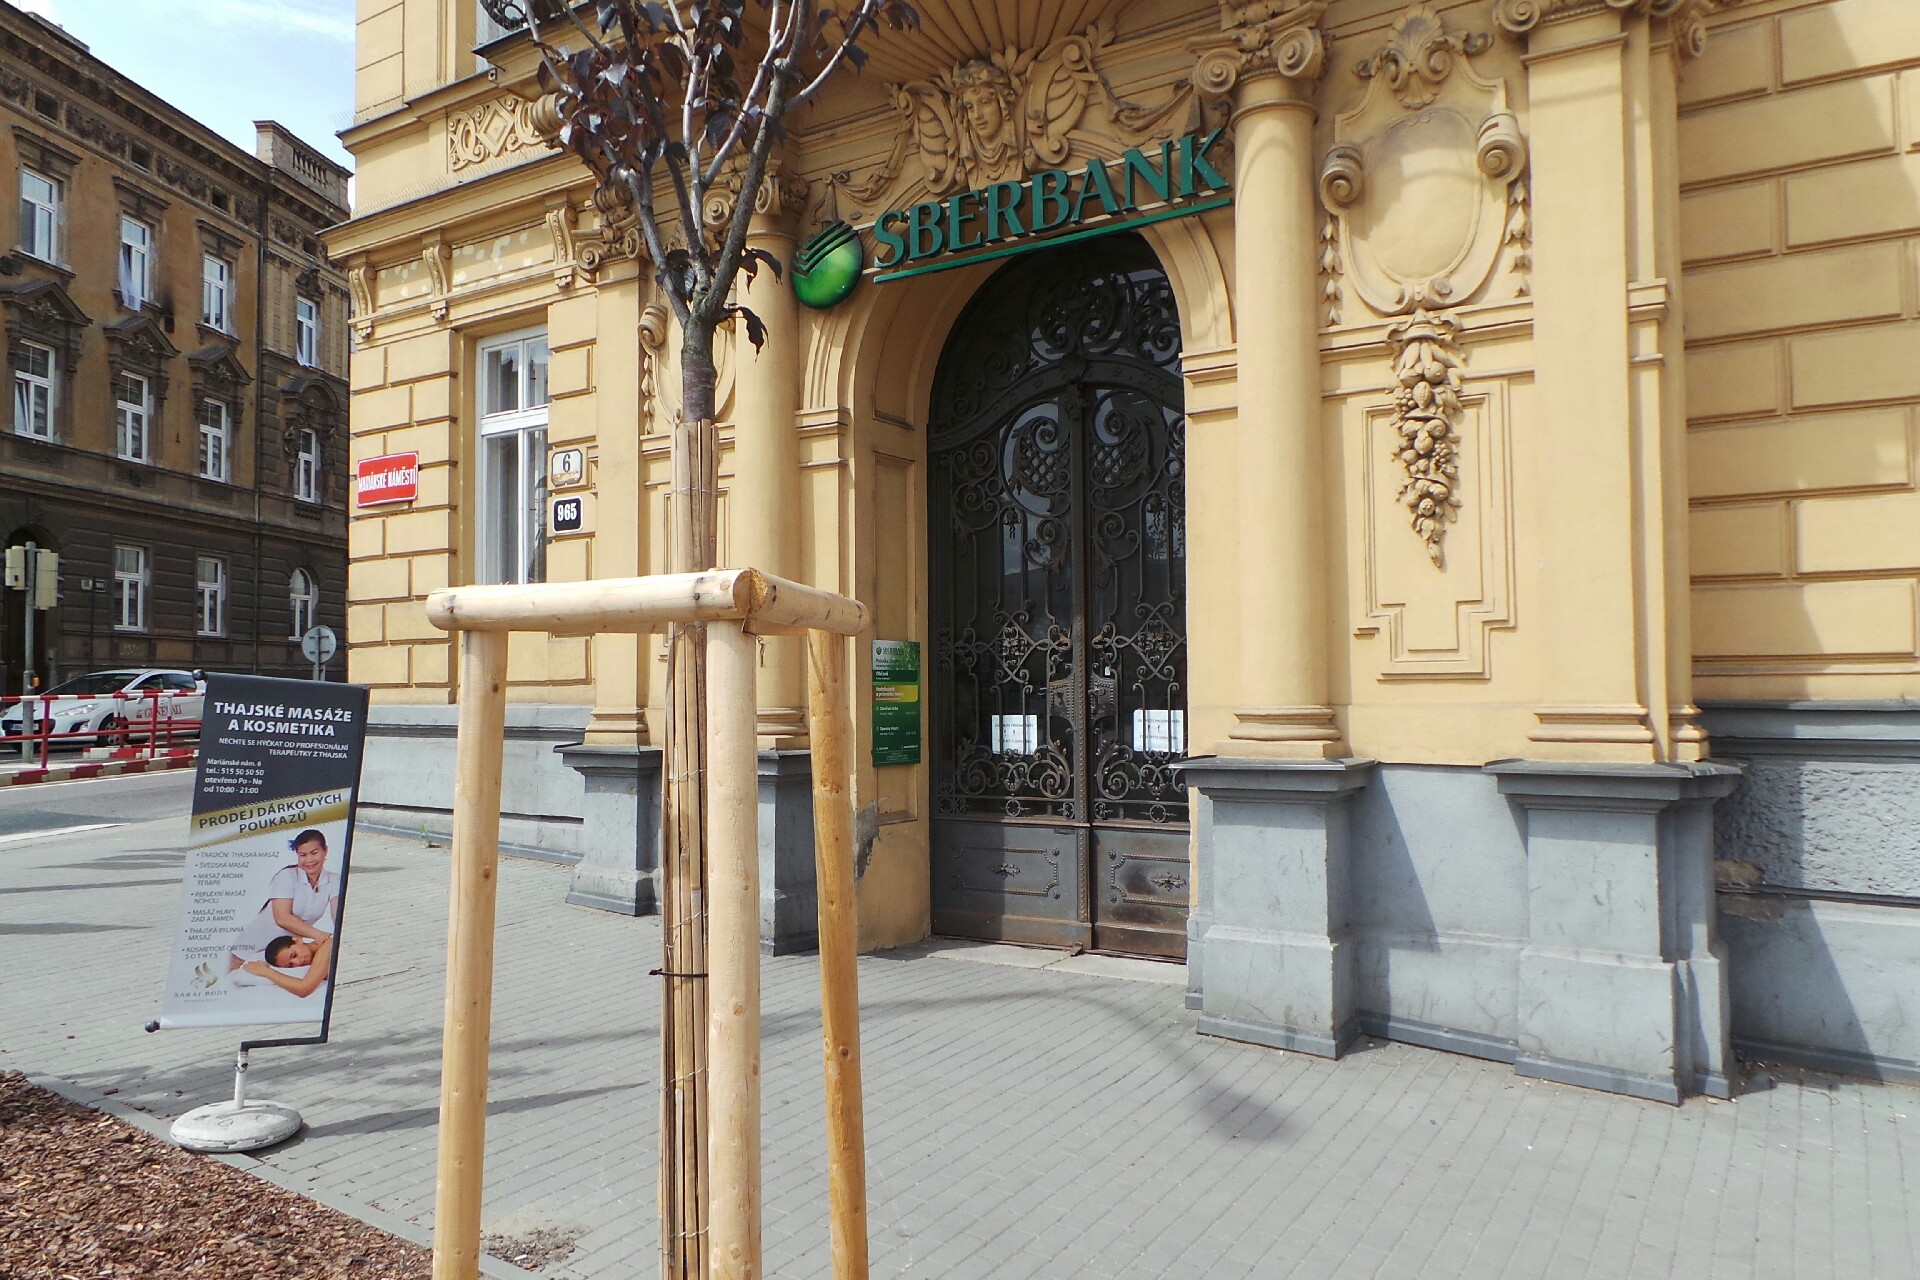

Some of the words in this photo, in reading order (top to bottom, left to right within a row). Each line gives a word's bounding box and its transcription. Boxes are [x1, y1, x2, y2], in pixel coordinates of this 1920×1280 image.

[873, 128, 1230, 268] SBERBANK
[562, 453, 571, 473] 6
[388, 465, 416, 487] NÁMĚSTÍ
[557, 503, 577, 521] 965
[214, 702, 284, 718] THAJSKÉ
[287, 706, 353, 722] MASÁŽE
[227, 719, 239, 731] A
[243, 720, 336, 737] KOSMETIKA
[219, 737, 246, 746] NECHTE
[256, 739, 284, 747] HYČKAT
[296, 742, 349, 751] PROFESIONÁLNÍ
[269, 749, 312, 757] TERAPEUTKY
[207, 758, 239, 766] Mariánské
[199, 809, 254, 828] PRODEJ
[257, 793, 342, 817] DÁRKOVÝCH
[239, 810, 307, 833] POUKAZŮ
